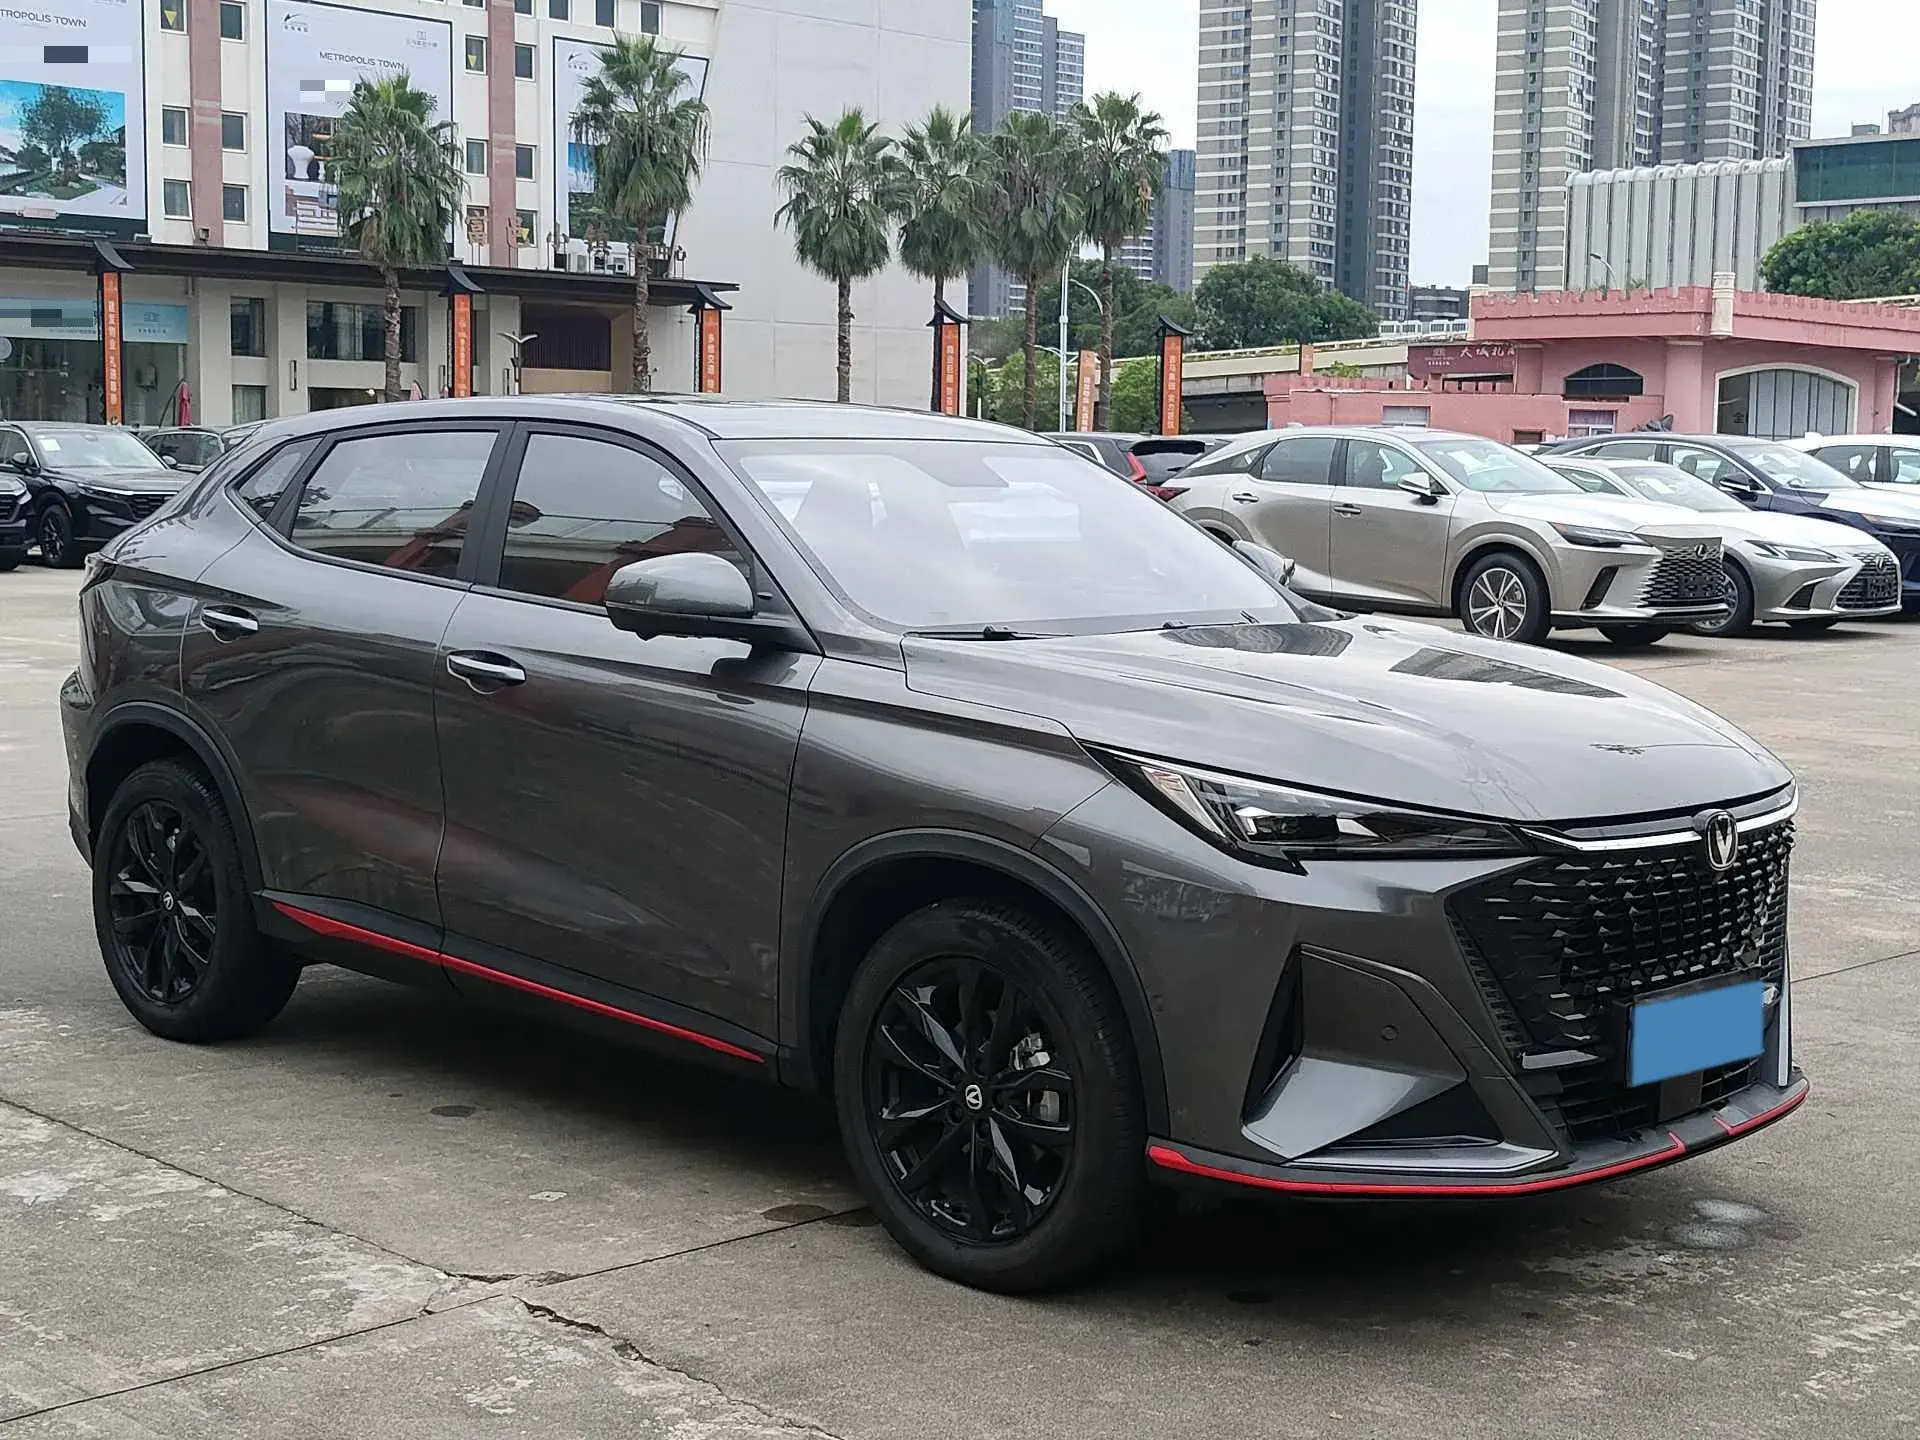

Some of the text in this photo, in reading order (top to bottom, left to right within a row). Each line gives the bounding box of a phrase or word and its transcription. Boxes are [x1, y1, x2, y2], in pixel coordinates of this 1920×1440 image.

[53, 15, 88, 28] TOWN
[319, 51, 404, 70] METROPOLIS TOWN
